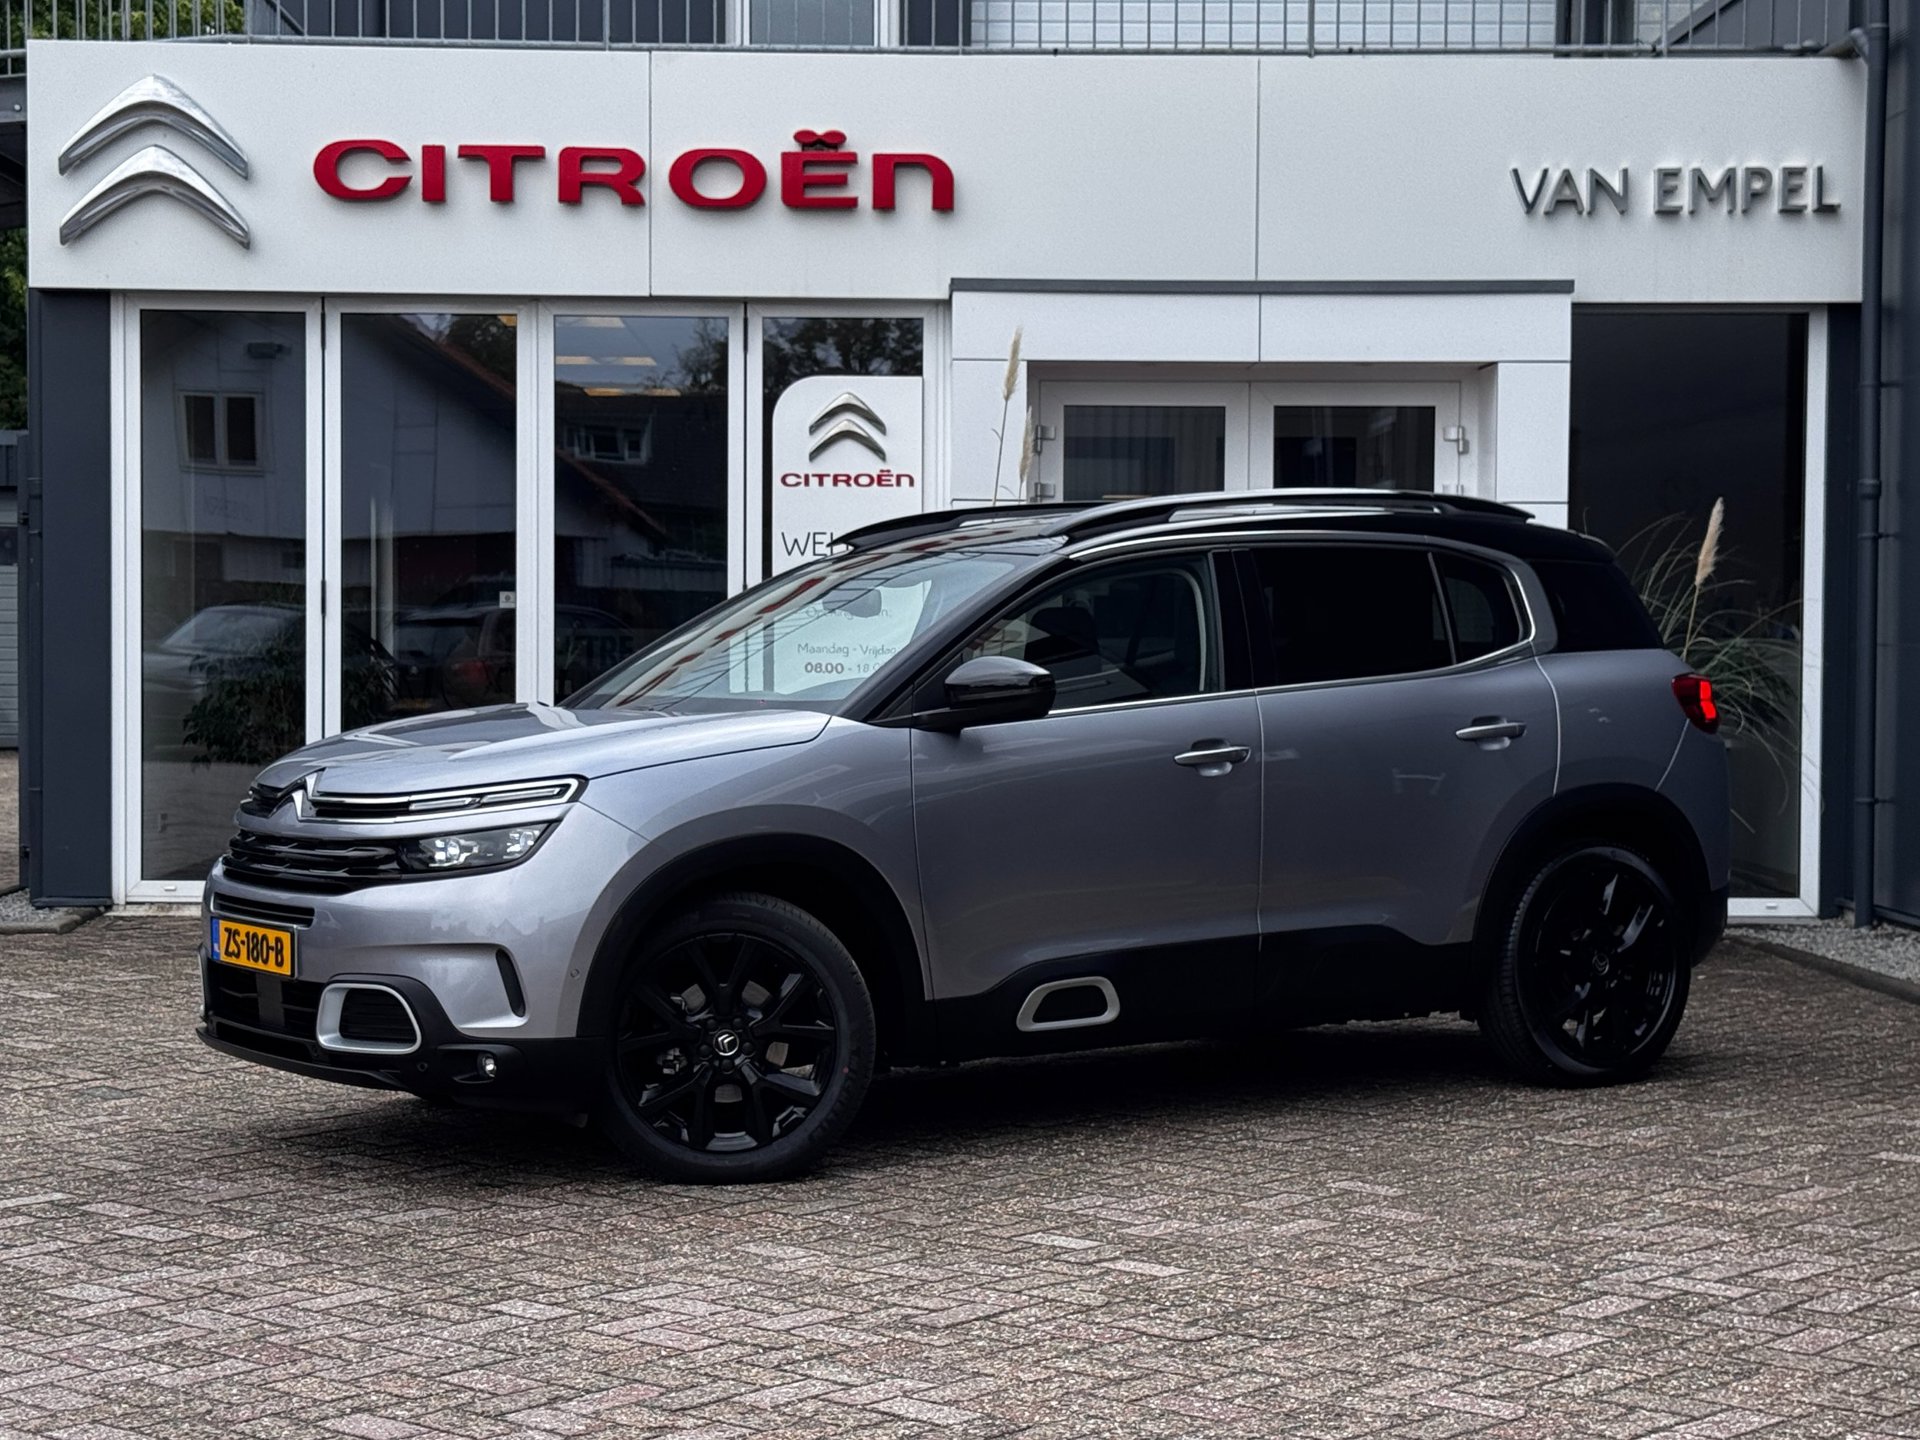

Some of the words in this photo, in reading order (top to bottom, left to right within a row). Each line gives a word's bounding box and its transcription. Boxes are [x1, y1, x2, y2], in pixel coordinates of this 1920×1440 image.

[1510, 166, 1629, 215] VAN
[1653, 165, 1842, 214] EMPEL
[797, 643, 850, 658] Maandag
[804, 661, 845, 675] 08.00
[224, 926, 285, 968] ZS-180-B
